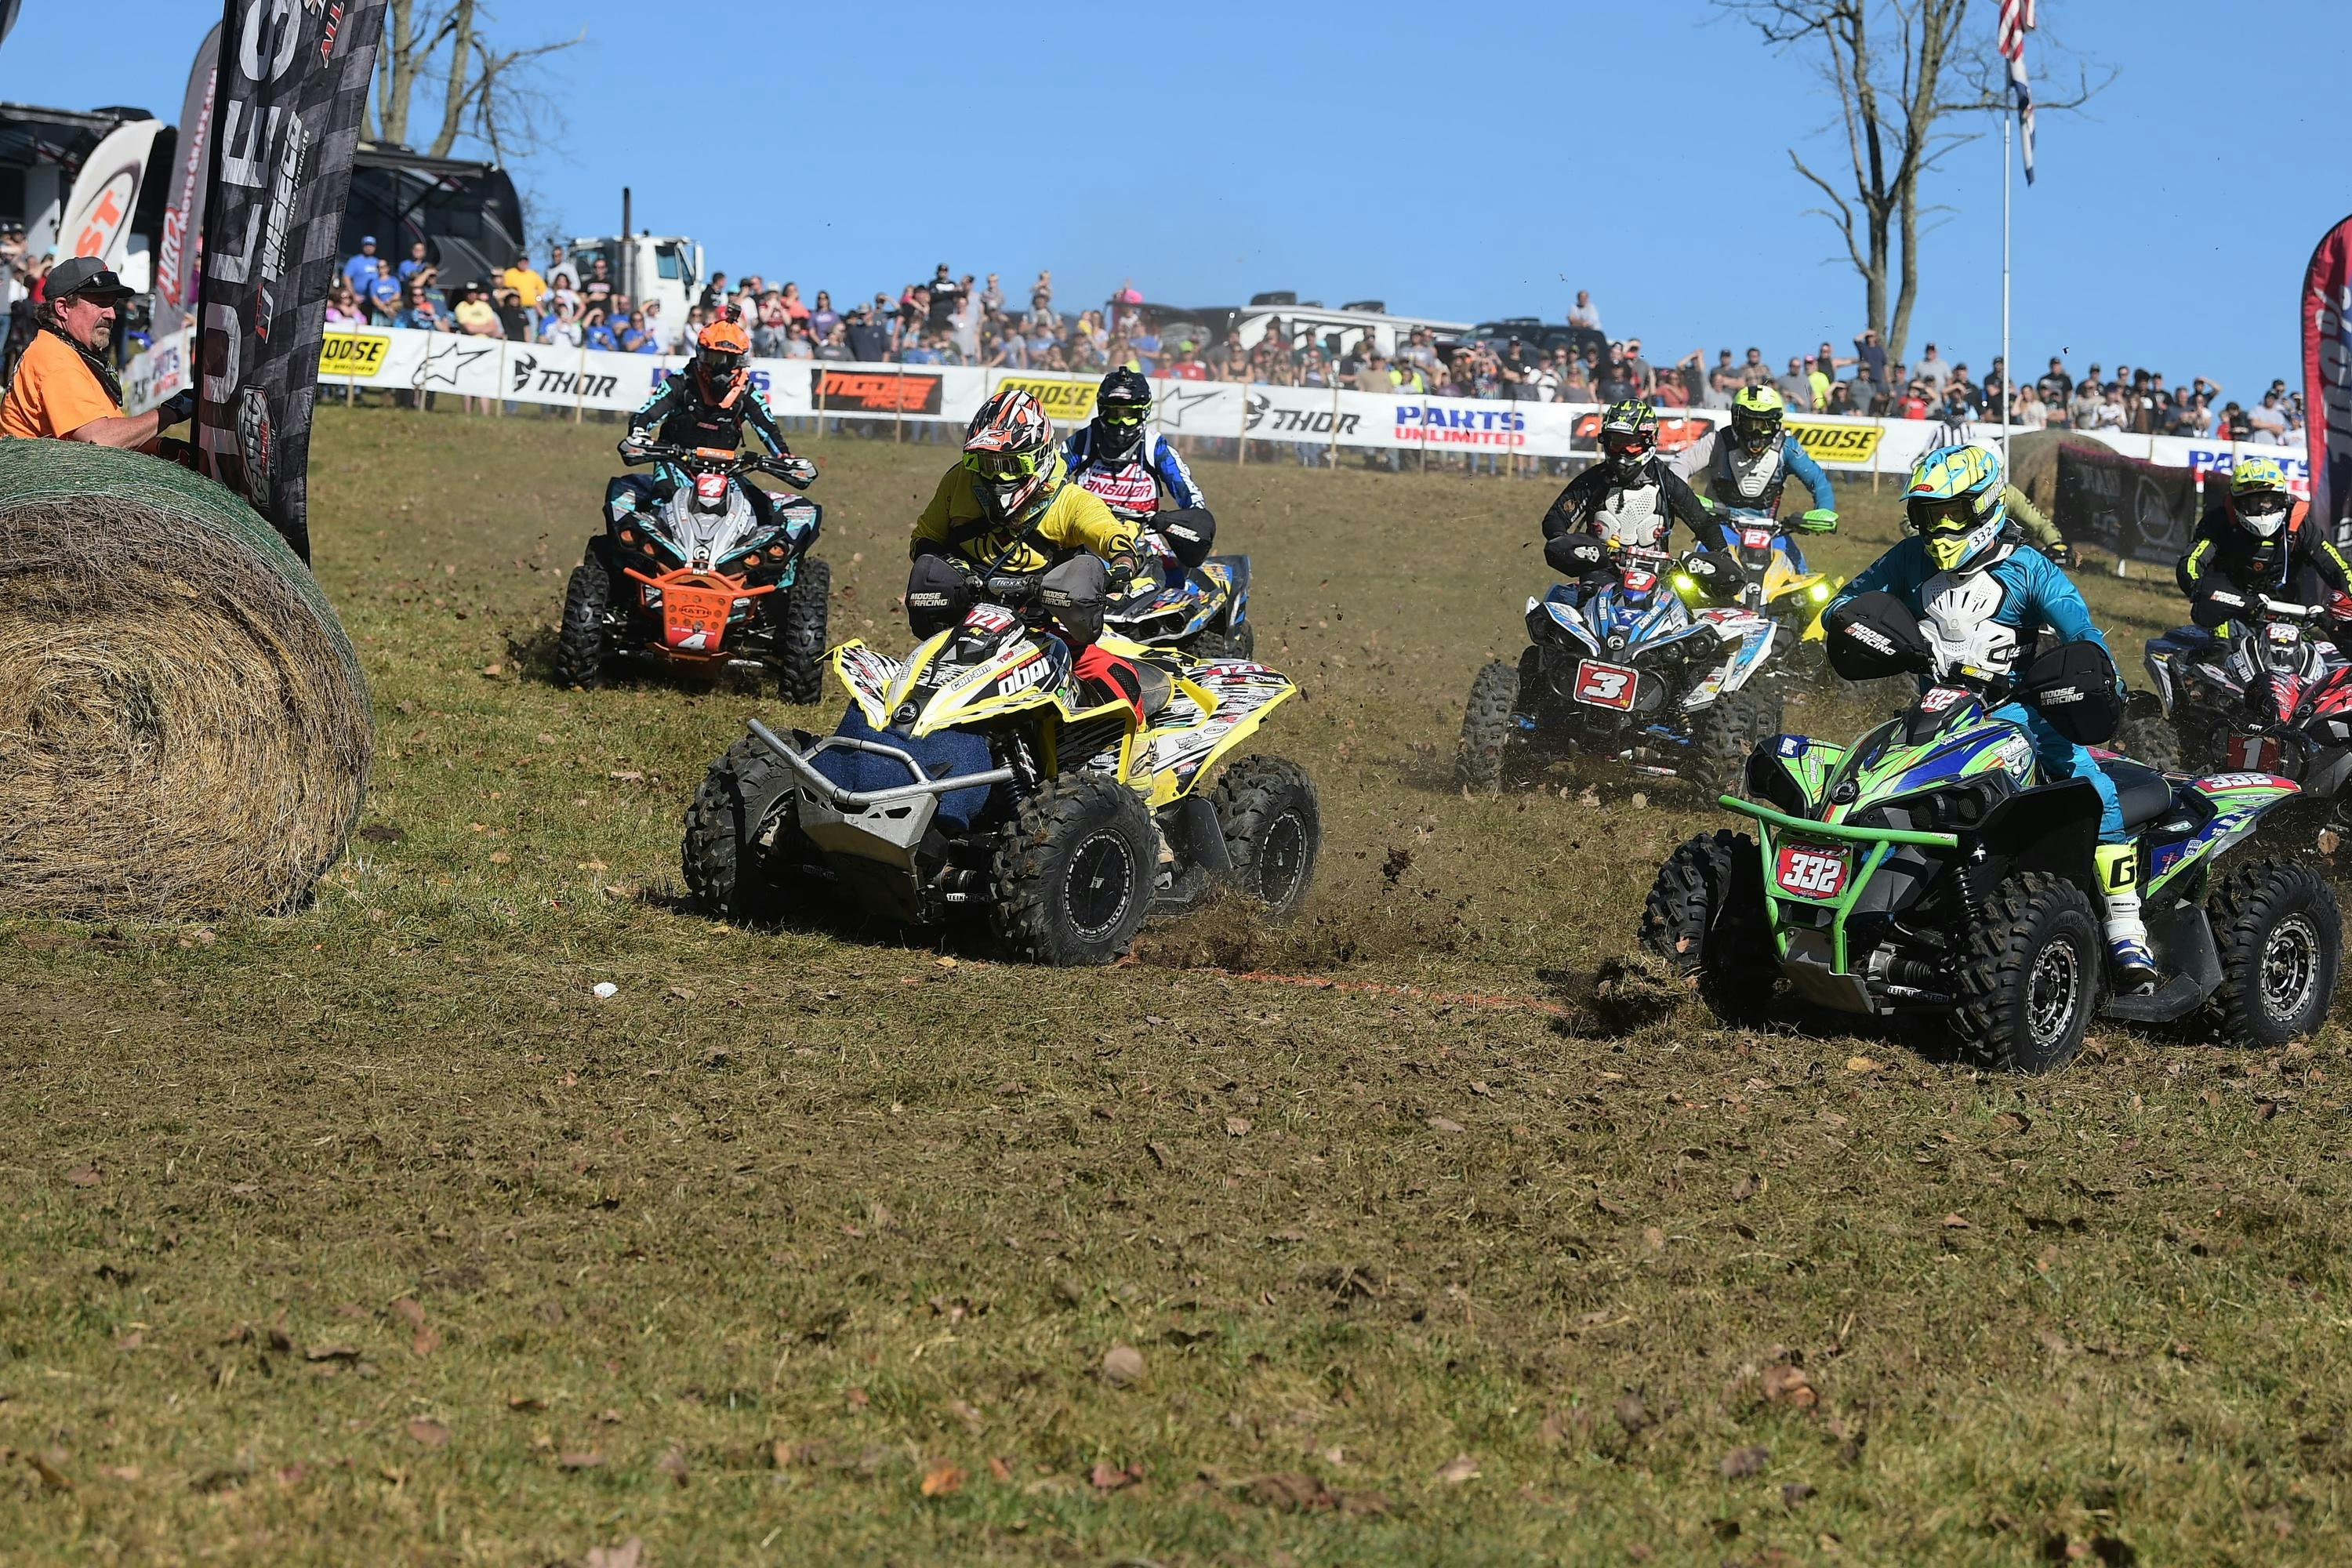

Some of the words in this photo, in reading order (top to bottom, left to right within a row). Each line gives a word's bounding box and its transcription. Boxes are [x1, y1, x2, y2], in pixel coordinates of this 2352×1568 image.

[320, 2, 344, 68] ALL
[293, 129, 310, 190] Products
[539, 370, 618, 397] THOR
[815, 372, 938, 397] MOOSE
[1273, 408, 1360, 434] THOR
[1396, 406, 1525, 431] PARTS
[1395, 427, 1526, 446] UNLIMITED
[700, 477, 723, 495] 4
[1171, 524, 1198, 536] MOOSE
[1173, 528, 1200, 542] RACING
[1744, 531, 1772, 546] 127
[1971, 526, 1992, 547] 332
[1627, 572, 1650, 585] 3
[1043, 590, 1068, 600] MOOSE
[1044, 597, 1072, 608] RACING
[2214, 590, 2241, 601] MOOSE
[2216, 597, 2245, 608] RACING
[966, 608, 1010, 630] 727
[1638, 605, 1663, 629] can-am
[677, 634, 706, 650] 4
[1851, 622, 1893, 645] MOOSE
[1852, 630, 1896, 656] RACING
[2270, 627, 2297, 640] 929
[950, 664, 992, 691] can-am
[2232, 653, 2254, 683] can-am
[1584, 672, 1628, 699] 3
[2041, 687, 2076, 698] MOOSE
[1922, 689, 1961, 710] 332
[2046, 692, 2085, 706] RACING
[2243, 737, 2264, 769] 1
[2204, 774, 2274, 789] 332
[1782, 853, 1842, 893] 332
